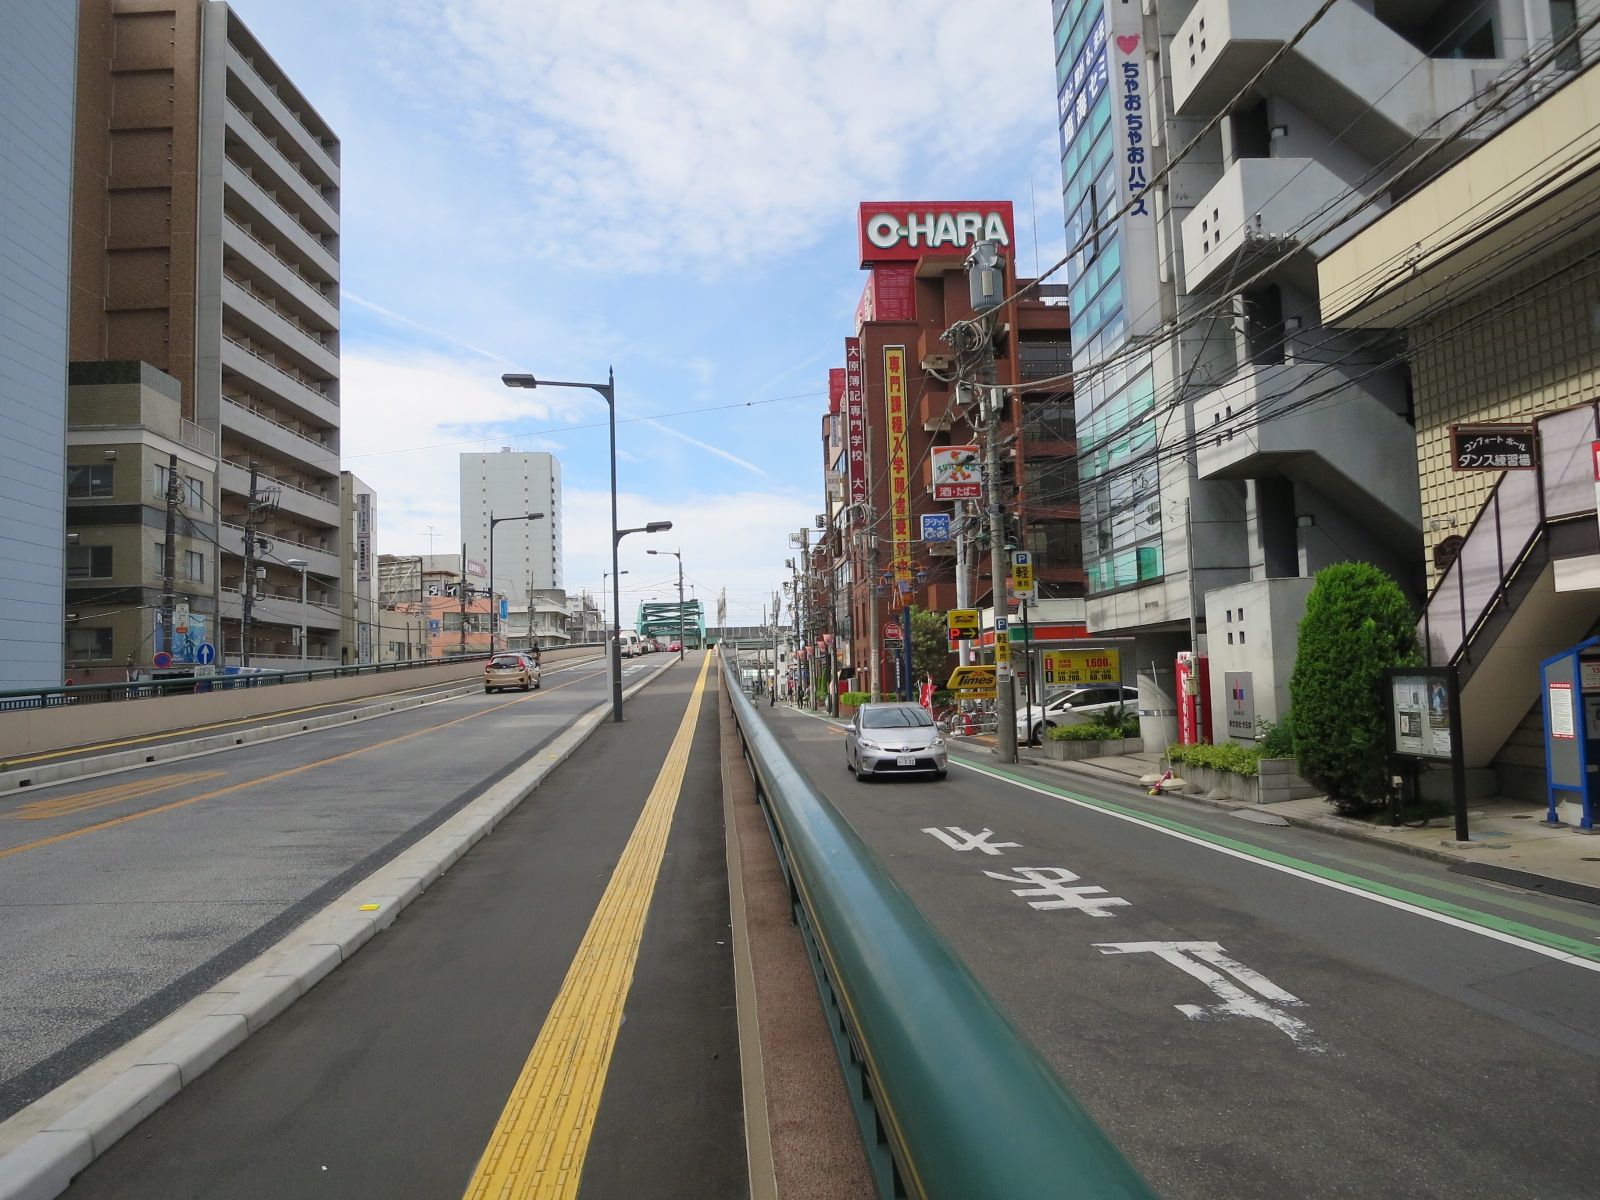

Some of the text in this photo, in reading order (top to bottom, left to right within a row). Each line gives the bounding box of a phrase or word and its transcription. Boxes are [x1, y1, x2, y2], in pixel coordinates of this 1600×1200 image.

[867, 212, 1010, 249] O-HARA
[847, 345, 863, 461] 大原簿記専門学校
[1464, 436, 1526, 452] コンフォート ホール
[1458, 454, 1531, 467] ダンス練習場
[940, 486, 977, 497] 酒・たばこ
[1017, 554, 1026, 563] P
[1016, 567, 1029, 579] 軽
[998, 619, 1006, 630] P
[951, 629, 960, 639] P
[996, 633, 1008, 644] 軽
[957, 674, 993, 687] Times
